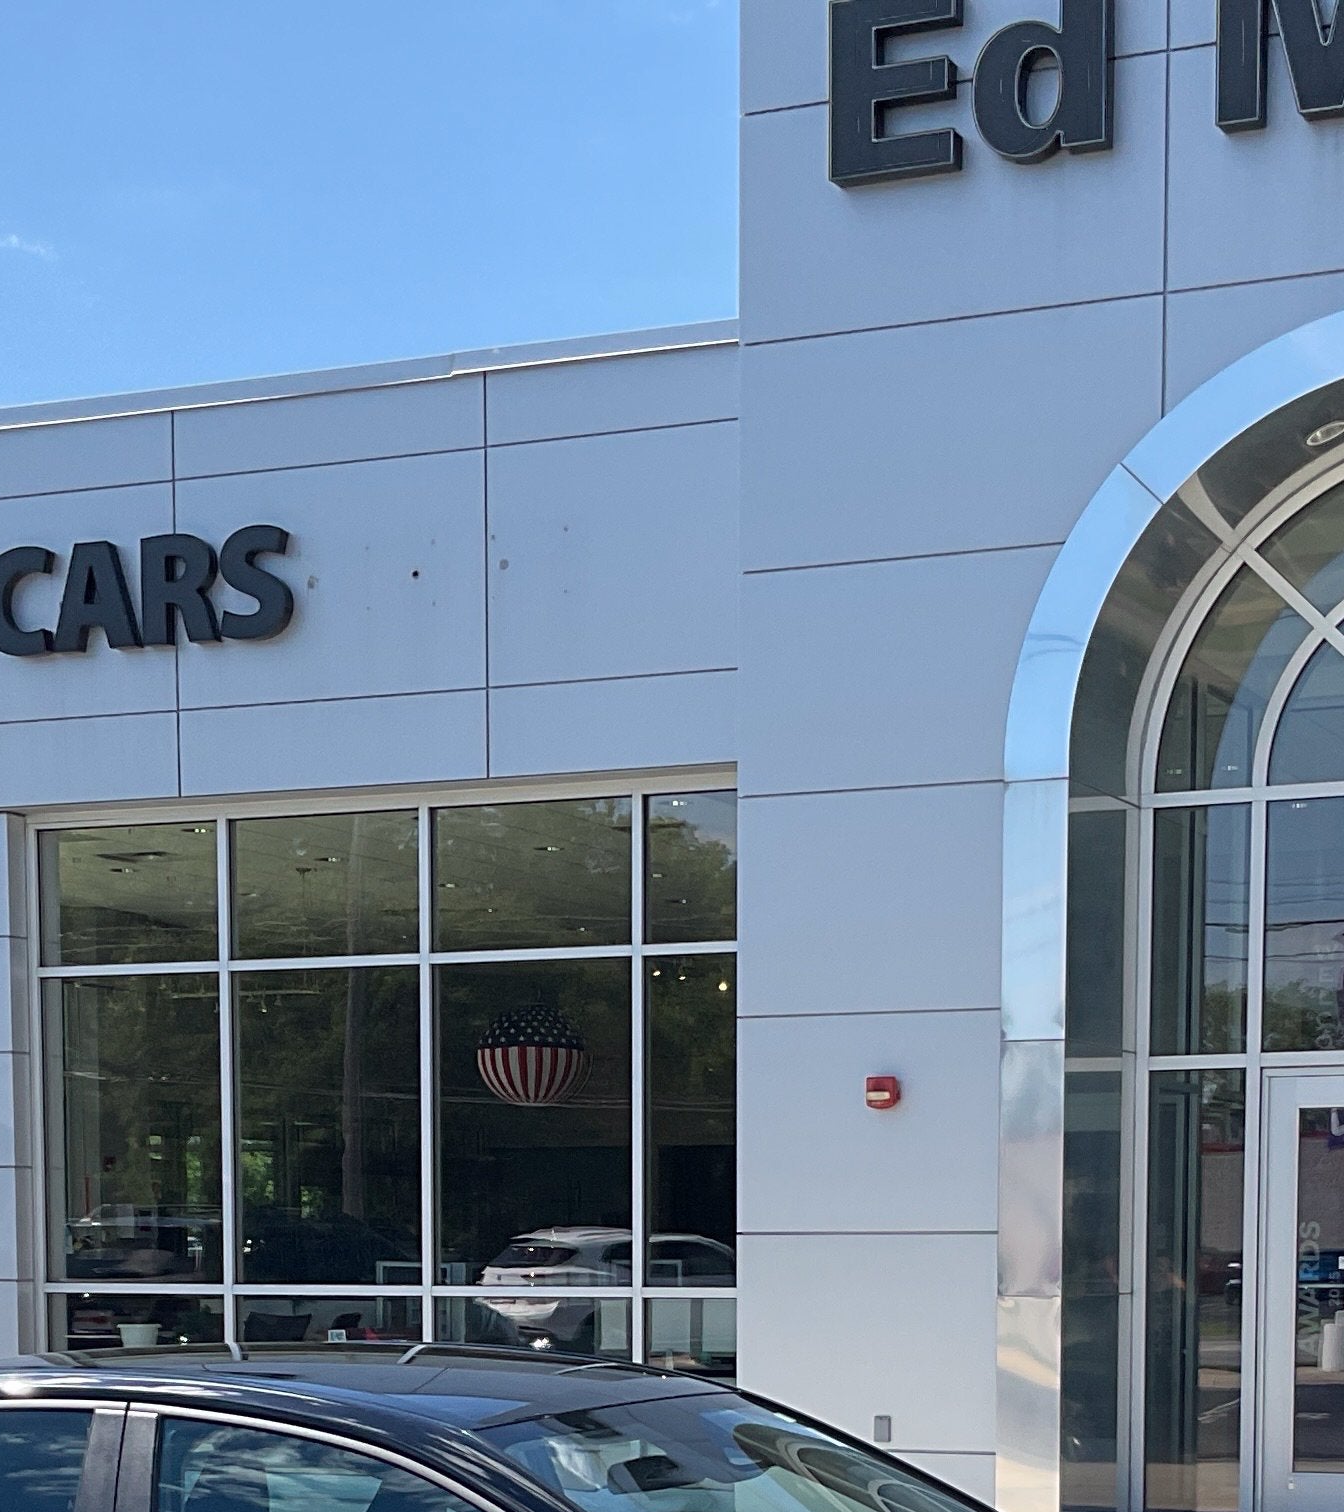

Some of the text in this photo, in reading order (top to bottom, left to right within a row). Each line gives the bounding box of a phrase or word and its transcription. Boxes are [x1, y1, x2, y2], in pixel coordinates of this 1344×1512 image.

[829, 0, 1114, 188] Ed
[1297, 1220, 1321, 1358] AWARDS
[1328, 1270, 1341, 1307] 205
